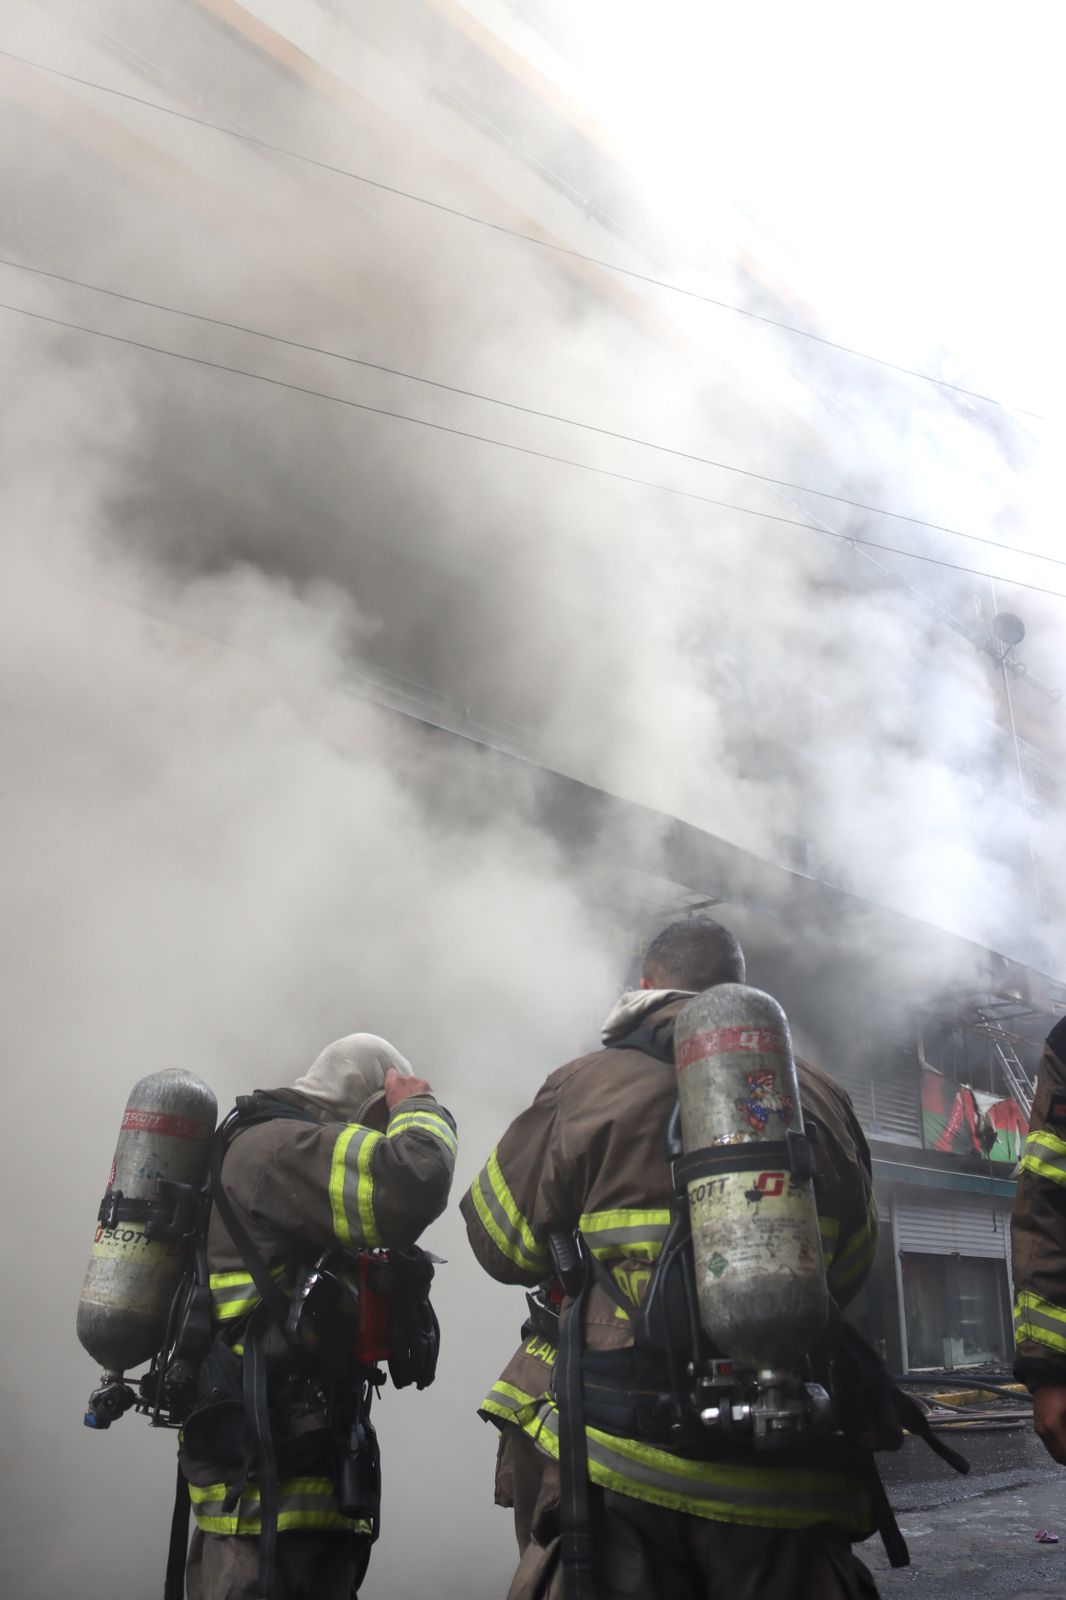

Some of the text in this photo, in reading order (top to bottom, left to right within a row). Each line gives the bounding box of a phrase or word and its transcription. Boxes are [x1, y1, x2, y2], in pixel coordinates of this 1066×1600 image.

[129, 1112, 162, 1124] SCOTT
[688, 1176, 730, 1205] COTT
[104, 1227, 151, 1246] SCOTT
